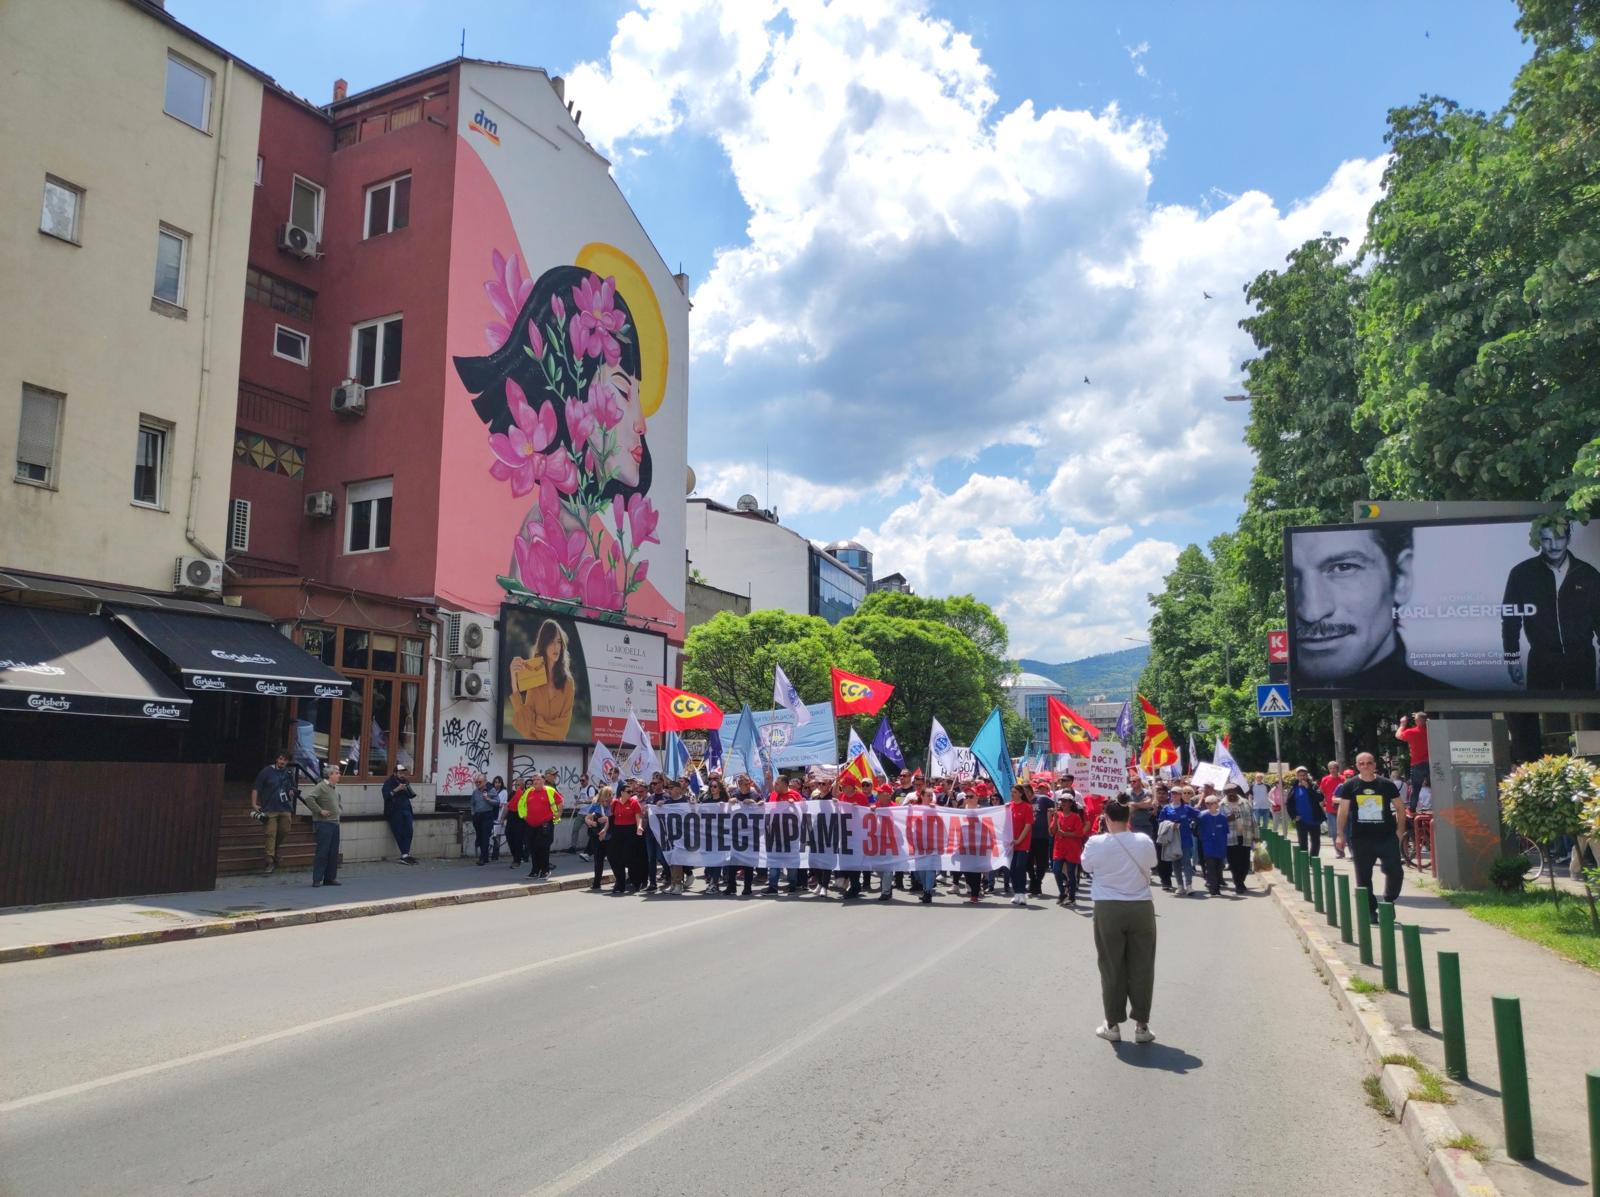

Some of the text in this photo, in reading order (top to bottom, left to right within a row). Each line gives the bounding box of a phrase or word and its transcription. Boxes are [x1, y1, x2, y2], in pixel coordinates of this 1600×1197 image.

[474, 109, 498, 135] dm
[1392, 603, 1537, 619] KARL LAGERFELD
[1271, 635, 1284, 648] K
[211, 649, 277, 665] Carlsberg
[193, 675, 226, 689] Carlsberg
[255, 680, 288, 695] Carlsberg
[314, 684, 344, 697] Carlsberg
[27, 694, 71, 712] Carlsberg
[142, 703, 181, 718] Carlsberg
[655, 812, 1000, 858] ПРОТЕСТИРАМЕ ЗА ПЛАТА
